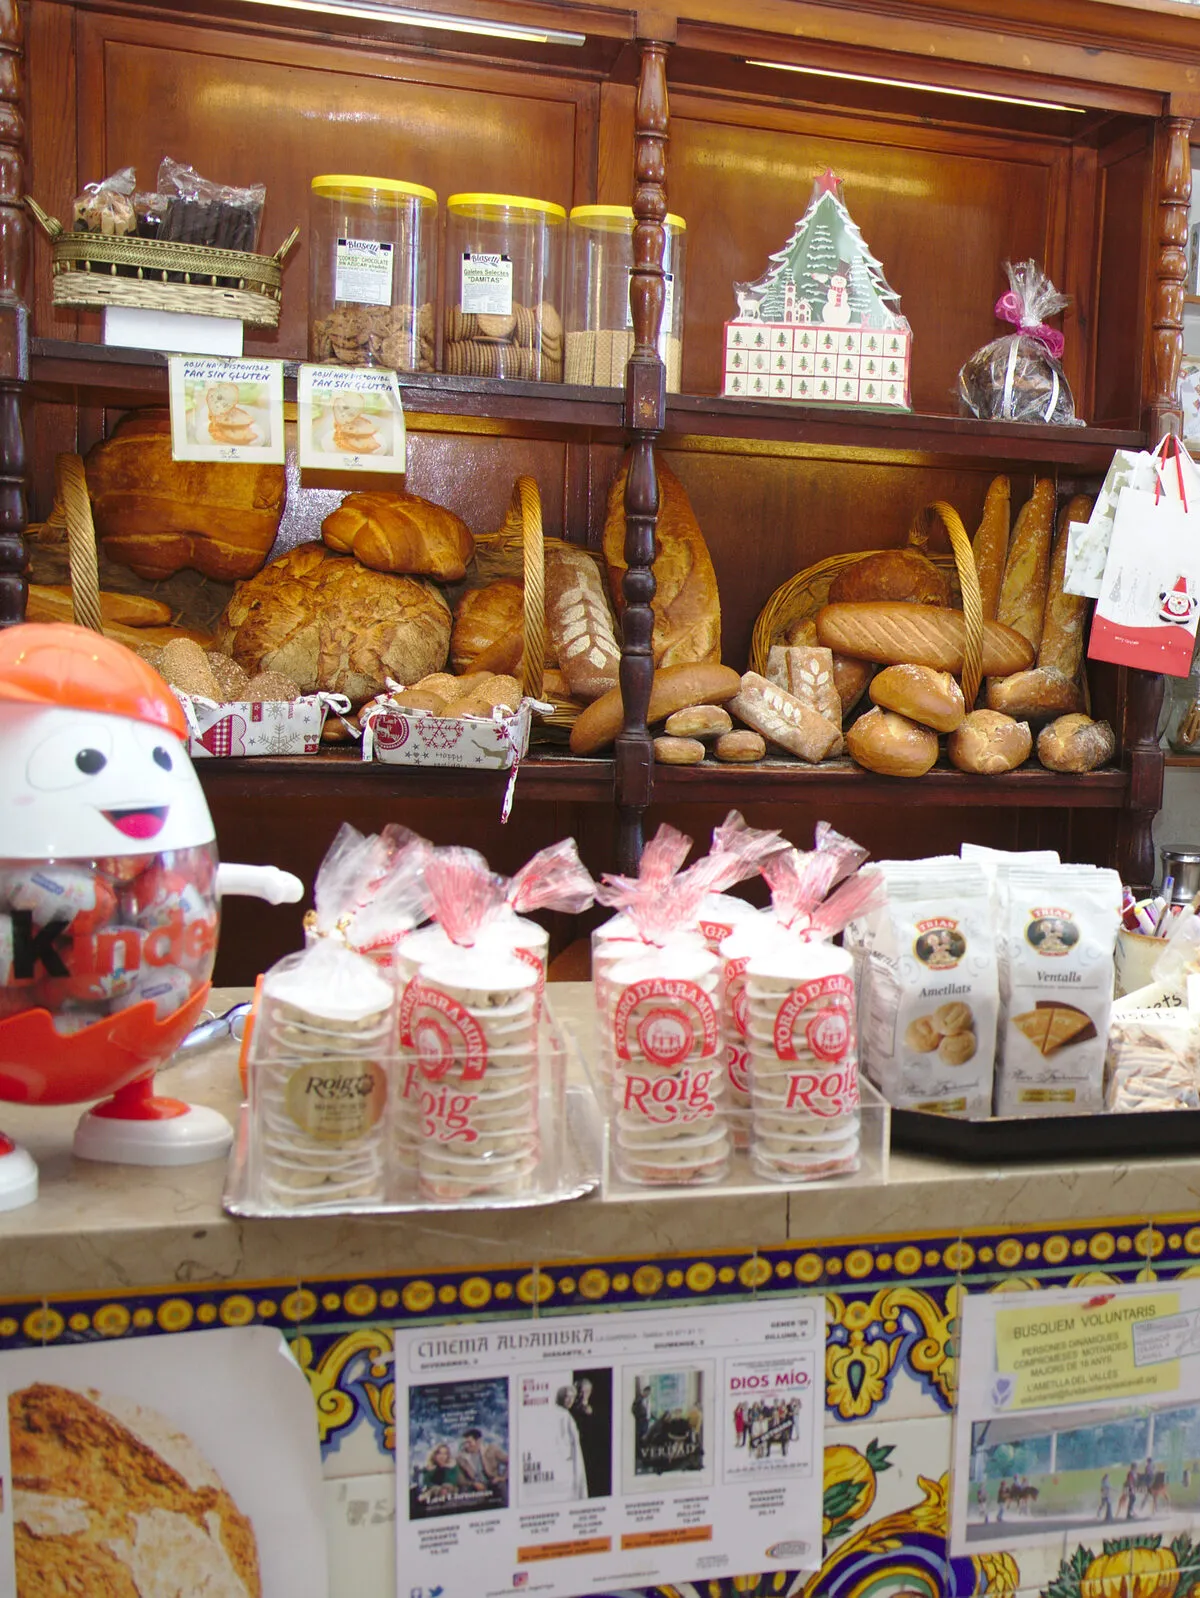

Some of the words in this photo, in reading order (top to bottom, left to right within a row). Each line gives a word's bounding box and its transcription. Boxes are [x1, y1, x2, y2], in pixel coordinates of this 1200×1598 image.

[484, 269, 509, 277] Selectes
[183, 370, 205, 378] PAN
[207, 371, 225, 380] SIN
[229, 371, 271, 382] GLUTEN
[312, 378, 332, 387] PAN
[335, 379, 351, 389] SIN
[354, 381, 393, 392] GLUTEN
[1033, 908, 1070, 920] TRIAS
[919, 919, 956, 932] TRIAS
[1036, 970, 1082, 984] Ventalls
[919, 983, 972, 999] Ametllats
[304, 1073, 355, 1100] Roig
[623, 1067, 716, 1124] Roig
[1013, 1318, 1075, 1340] BUSQUEM
[1080, 1304, 1157, 1328] VOLUNTARIS
[417, 1336, 489, 1359] CINEMA
[497, 1328, 595, 1351] ALHAMBRA
[729, 1373, 770, 1391] DIOS
[774, 1369, 814, 1388] MÍO,
